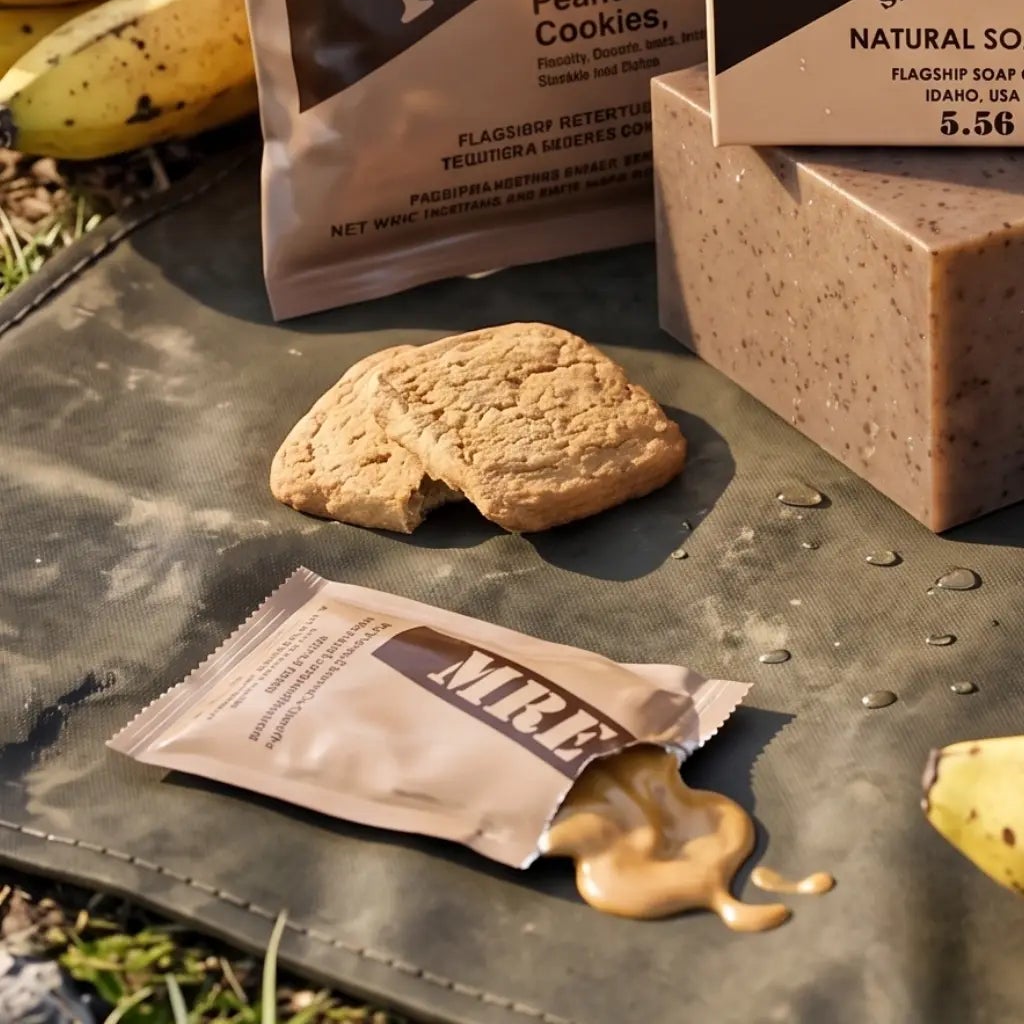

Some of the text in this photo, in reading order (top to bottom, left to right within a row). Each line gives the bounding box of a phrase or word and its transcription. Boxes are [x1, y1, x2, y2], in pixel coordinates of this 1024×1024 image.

[535, 8, 668, 47] Cookies,
[850, 27, 976, 50] NATURAL
[891, 67, 968, 81] FLAGSHIP
[972, 68, 1017, 82] SOAP
[925, 88, 984, 104] IDAHO,
[989, 88, 1020, 103] USA
[940, 110, 1015, 136] 5.56
[331, 220, 368, 237] NET
[426, 650, 619, 763] MRE
